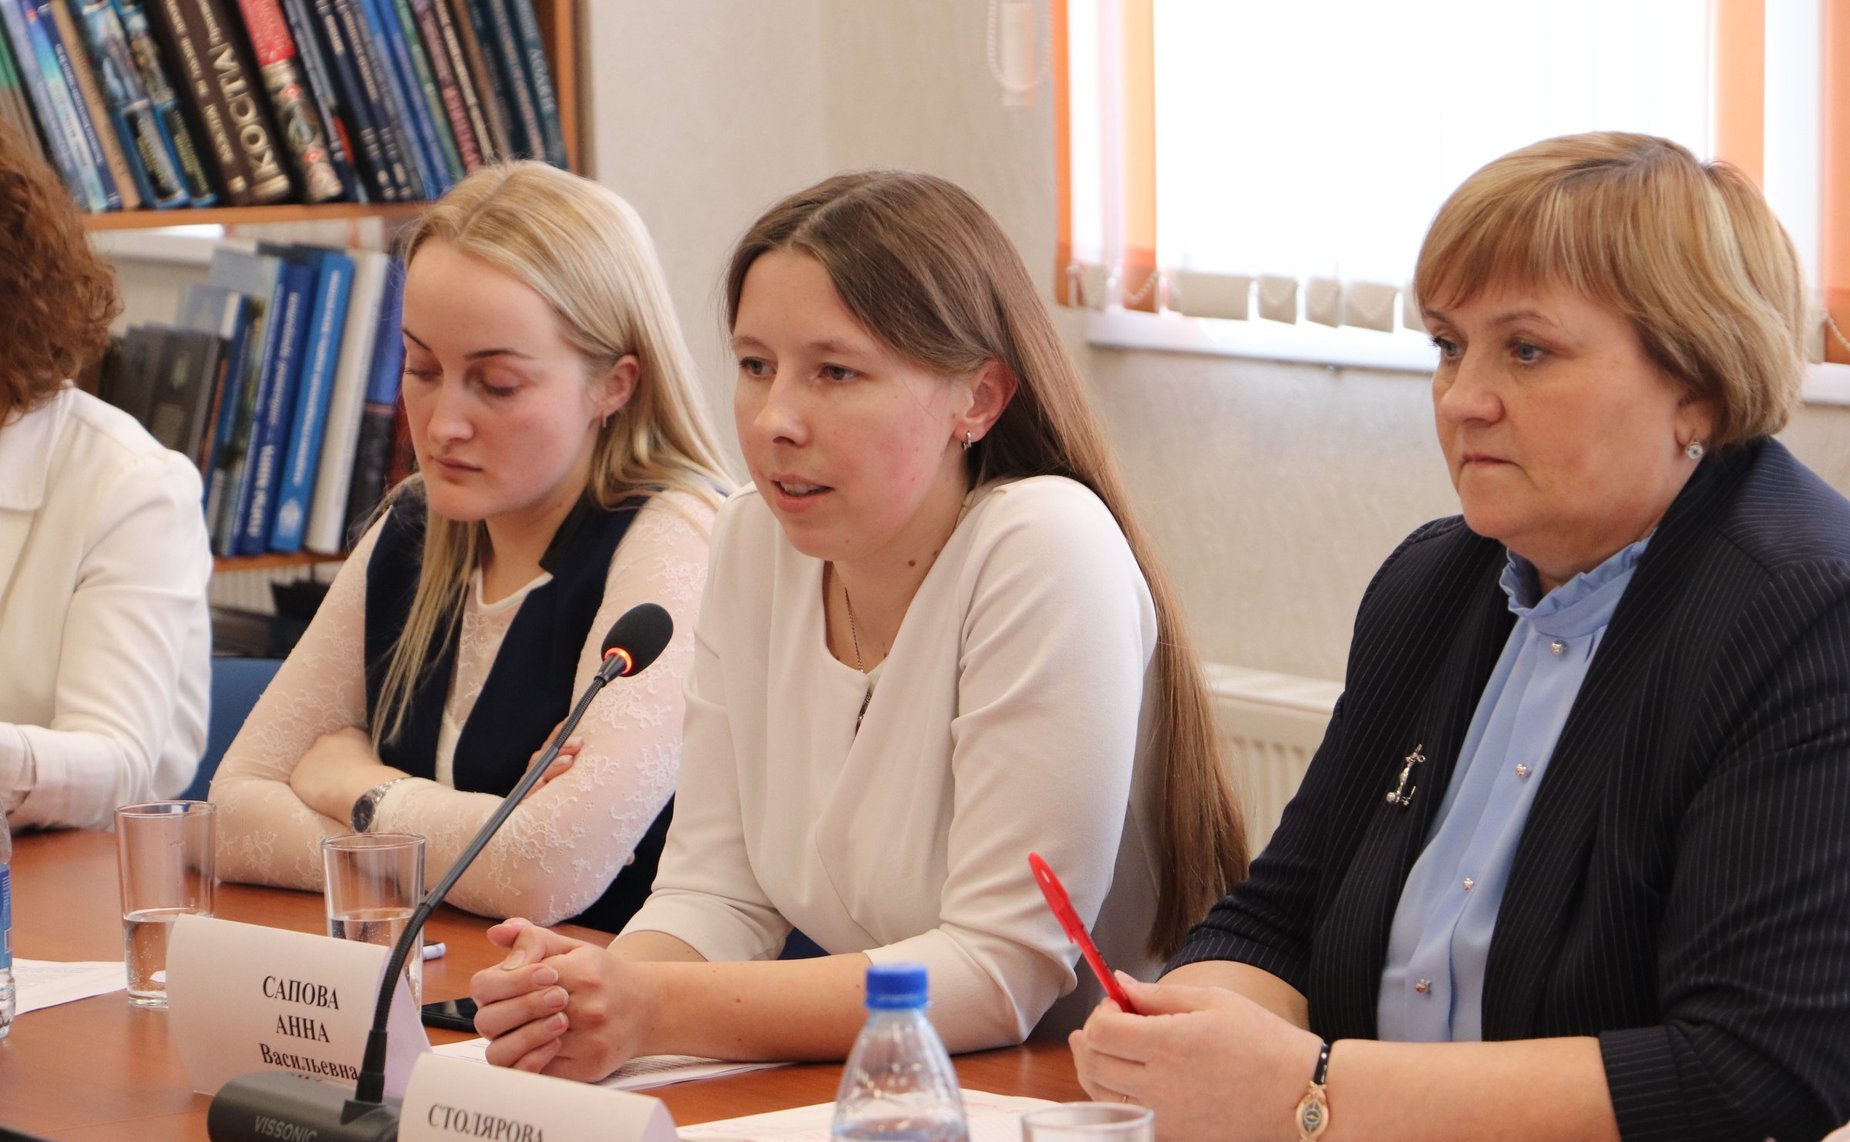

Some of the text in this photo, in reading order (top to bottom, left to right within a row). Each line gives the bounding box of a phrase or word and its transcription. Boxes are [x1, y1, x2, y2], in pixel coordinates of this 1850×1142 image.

[212, 45, 281, 180] КОСТА
[262, 975, 340, 1010] САПОВА
[275, 1014, 330, 1043] АННА
[259, 1042, 358, 1081] Васильевна
[427, 1103, 544, 1142] СТОЛЯРОВА
